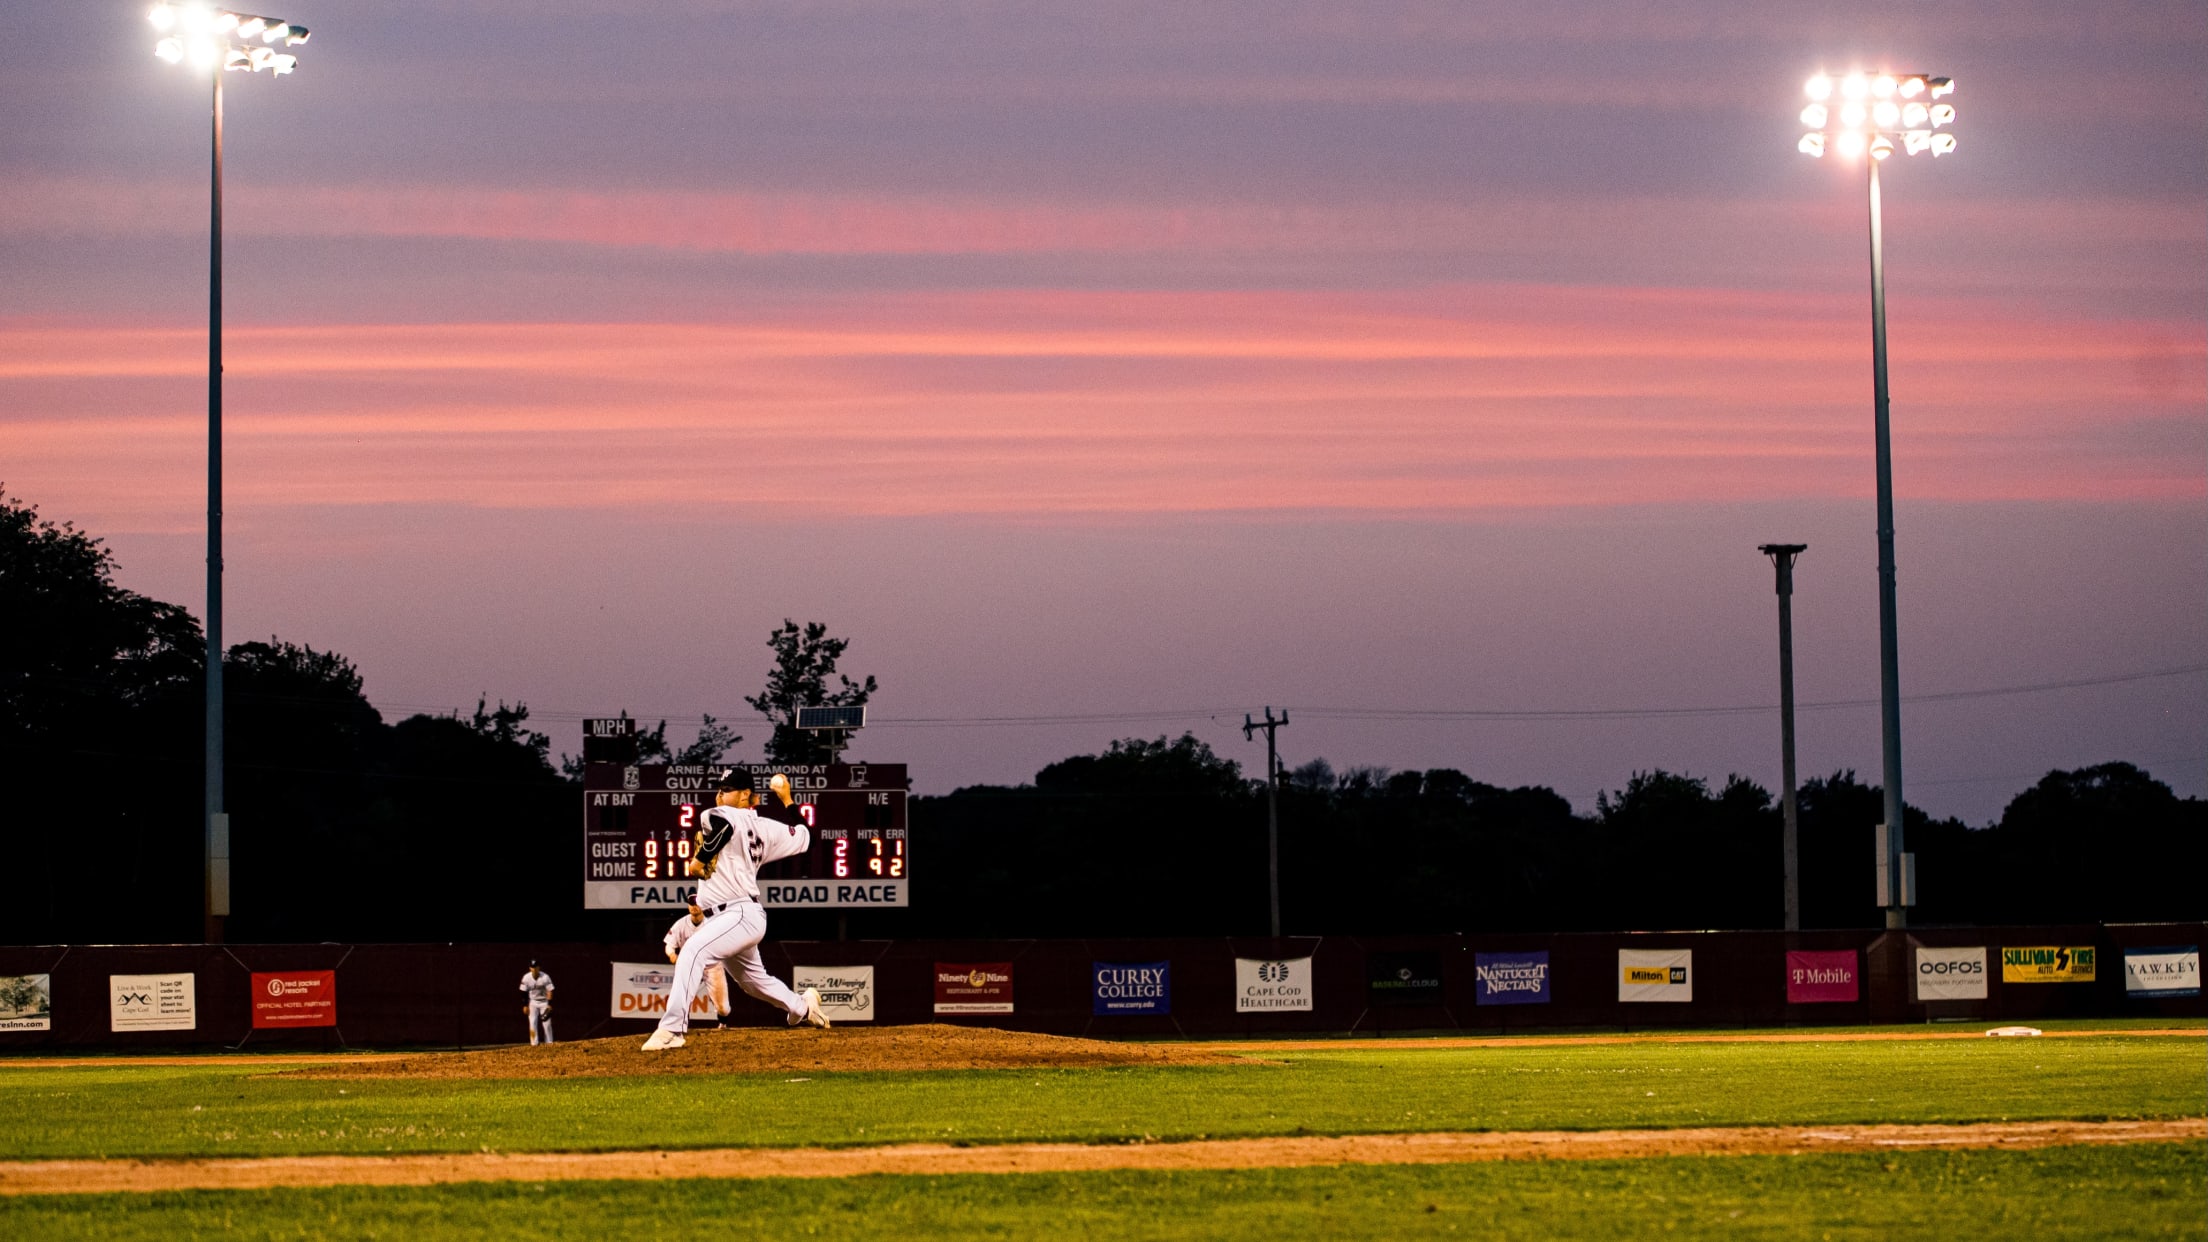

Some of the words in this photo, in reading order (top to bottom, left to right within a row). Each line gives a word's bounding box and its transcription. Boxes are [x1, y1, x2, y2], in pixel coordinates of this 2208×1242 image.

[593, 720, 626, 734] MPH
[666, 765, 704, 775] ARNIE
[752, 765, 809, 775] DIAMOND
[811, 765, 828, 775] AT
[666, 777, 703, 789] GUV
[787, 777, 828, 789] IELD
[594, 793, 609, 806] AT
[612, 793, 636, 806] BAT
[671, 793, 702, 806] BALL
[794, 793, 819, 806] OUT
[868, 792, 889, 806] H/E
[680, 805, 694, 828] 2
[665, 830, 671, 840] 2
[821, 829, 848, 840] RUNS
[857, 829, 879, 840] HITS
[886, 829, 905, 839] ERR
[592, 843, 637, 858] GUEST
[593, 862, 636, 877] HOME
[631, 887, 697, 904] FALM
[767, 886, 828, 903] ROAD
[838, 885, 896, 902] RACE
[2004, 949, 2055, 966] SULLIVAN
[2070, 949, 2094, 965] TIRE
[1476, 963, 1548, 981] NANTUCKET
[1920, 961, 1983, 974] OOFOS
[2037, 966, 2053, 974] AUTO
[2128, 962, 2196, 975] YAWKEY
[938, 973, 969, 983] Ninety
[986, 973, 1008, 982] Nine
[1098, 968, 1165, 985] CURRY
[1631, 971, 1663, 980] Milton
[1671, 971, 1685, 980] CAT
[1792, 968, 1805, 985] T
[1806, 968, 1852, 984] Mobile
[1098, 985, 1164, 998] COLLEGE
[1247, 986, 1275, 996] CAPE
[1277, 986, 1302, 996] COD
[1487, 979, 1541, 995] NECTARS
[620, 993, 709, 1013] DUNN
[821, 993, 854, 1003] OTTERY
[1240, 997, 1309, 1008] HEALTHCARE
